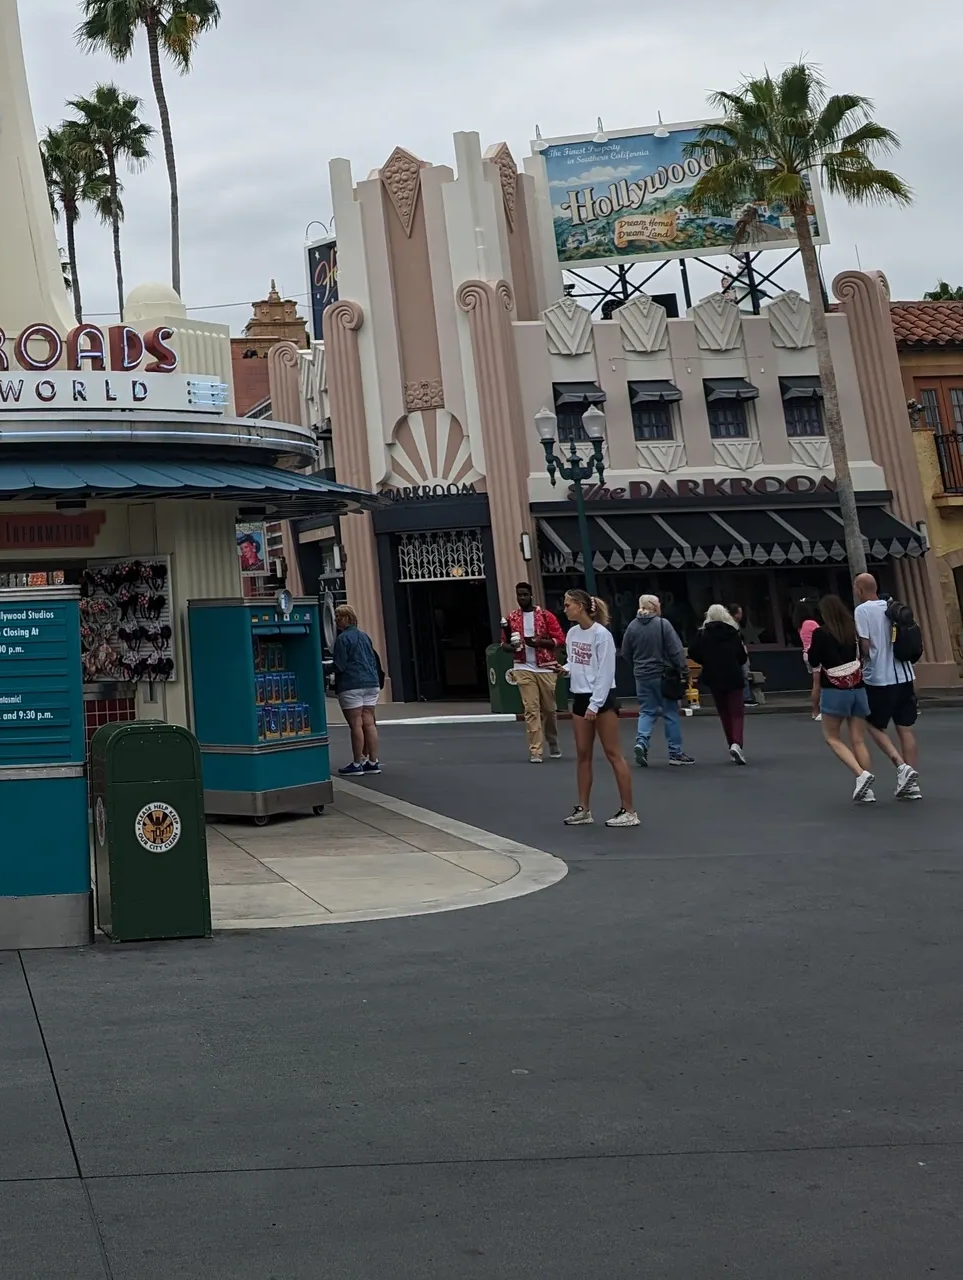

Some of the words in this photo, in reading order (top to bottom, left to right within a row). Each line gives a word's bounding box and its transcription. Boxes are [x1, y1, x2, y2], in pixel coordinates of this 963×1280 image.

[548, 149, 562, 158] The
[563, 147, 586, 157] Finest
[587, 144, 621, 154] Property
[567, 157, 575, 165] in
[576, 155, 609, 164] Southern
[610, 149, 649, 160] California
[561, 147, 718, 227] Hollywood
[618, 219, 647, 229] Dream
[648, 218, 673, 227] Homes
[618, 230, 645, 239] Dream
[646, 228, 670, 239] Land
[567, 482, 626, 501] The
[28, 610, 54, 620] Studios
[3, 627, 30, 638] Closing
[31, 627, 39, 636] At
[8, 646, 25, 655] p.m.
[3, 711, 17, 720] and
[18, 710, 36, 719] 9:30
[37, 711, 54, 720] p.m.
[137, 806, 152, 826] PLEASE
[168, 810, 179, 825] KEEP
[138, 832, 148, 846] OUR
[164, 832, 178, 849] CLEAN
